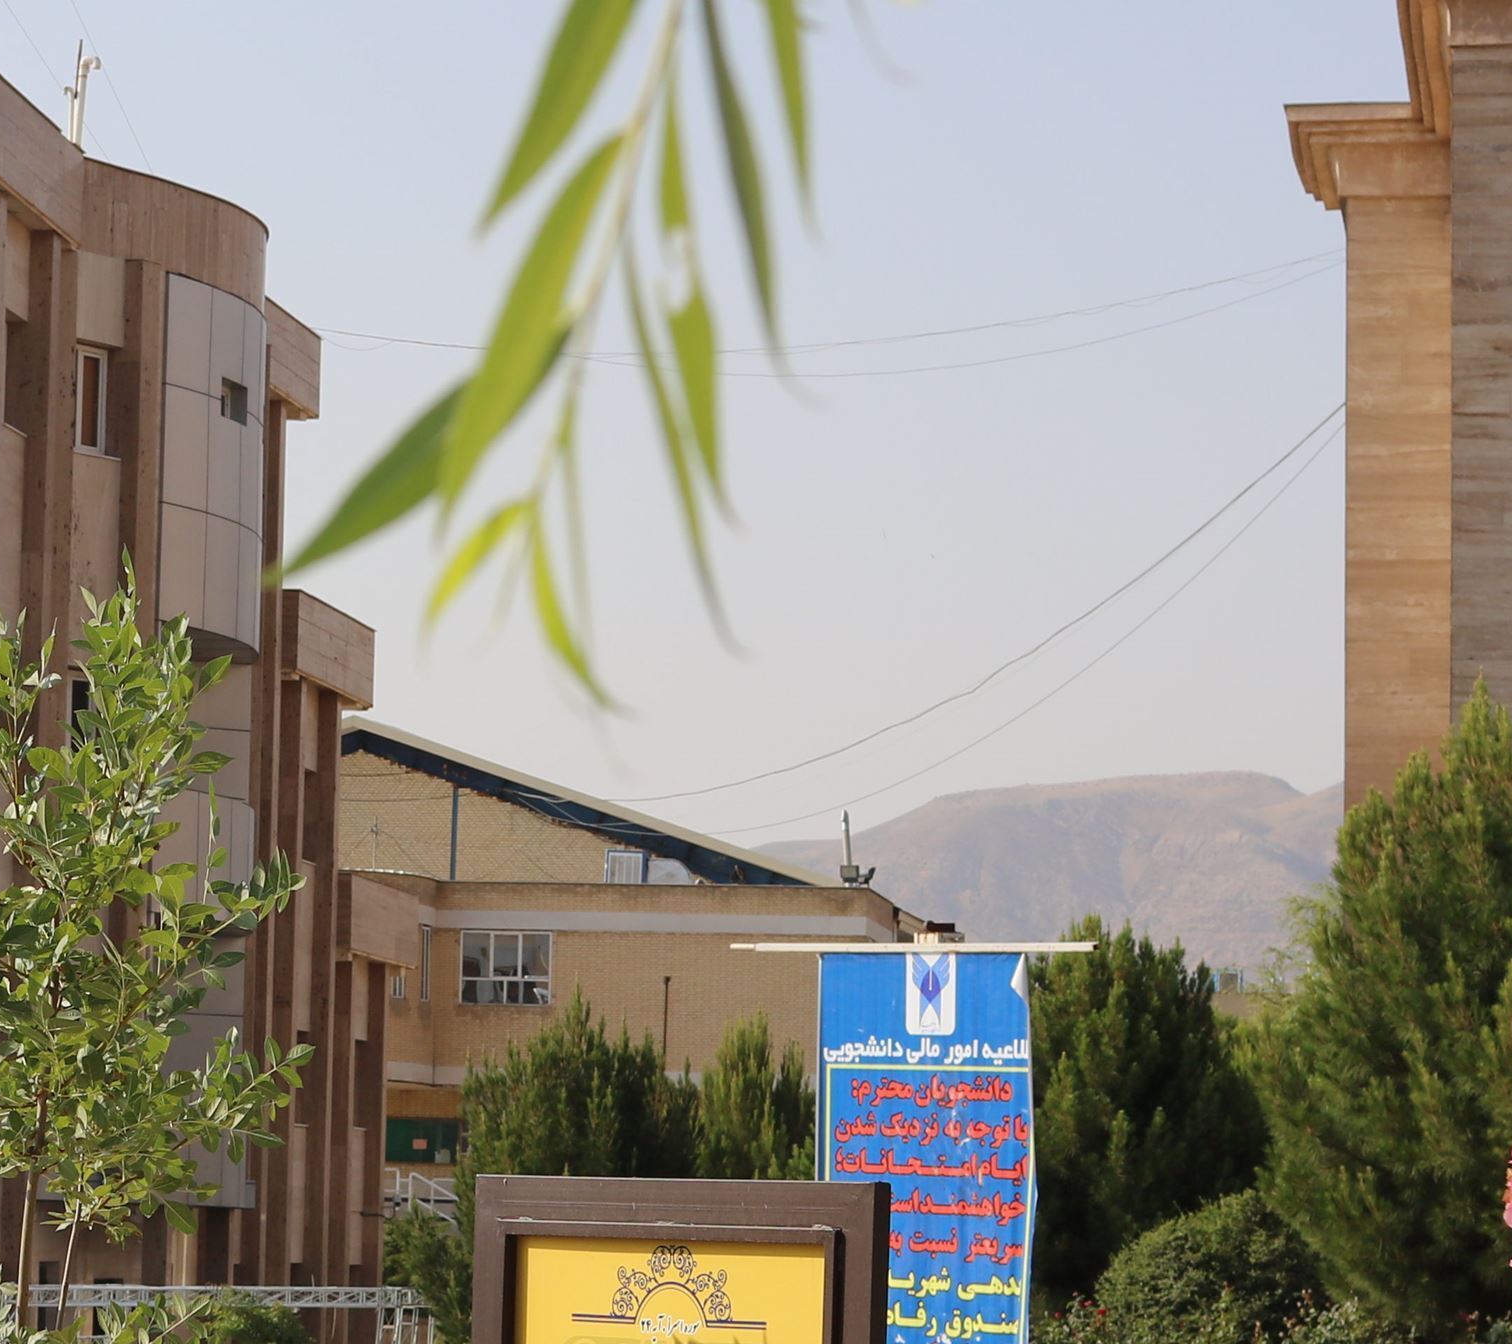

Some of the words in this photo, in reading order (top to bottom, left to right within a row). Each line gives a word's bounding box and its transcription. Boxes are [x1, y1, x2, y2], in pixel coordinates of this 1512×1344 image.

[823, 1035, 904, 1063] دانشجویی
[906, 1037, 940, 1064] مالی
[944, 1039, 978, 1065] امور
[982, 1039, 1029, 1065] لاعیه
[915, 1072, 1014, 1109] دانشجویان
[835, 1111, 877, 1143] شدن
[880, 1112, 939, 1146] نزدیک
[943, 1119, 962, 1145] به
[966, 1116, 1010, 1148] توجه
[1013, 1114, 1029, 1148] با
[908, 1228, 959, 1258] نسبت
[965, 1233, 1024, 1264] سریعتر
[888, 1268, 950, 1297] شهری
